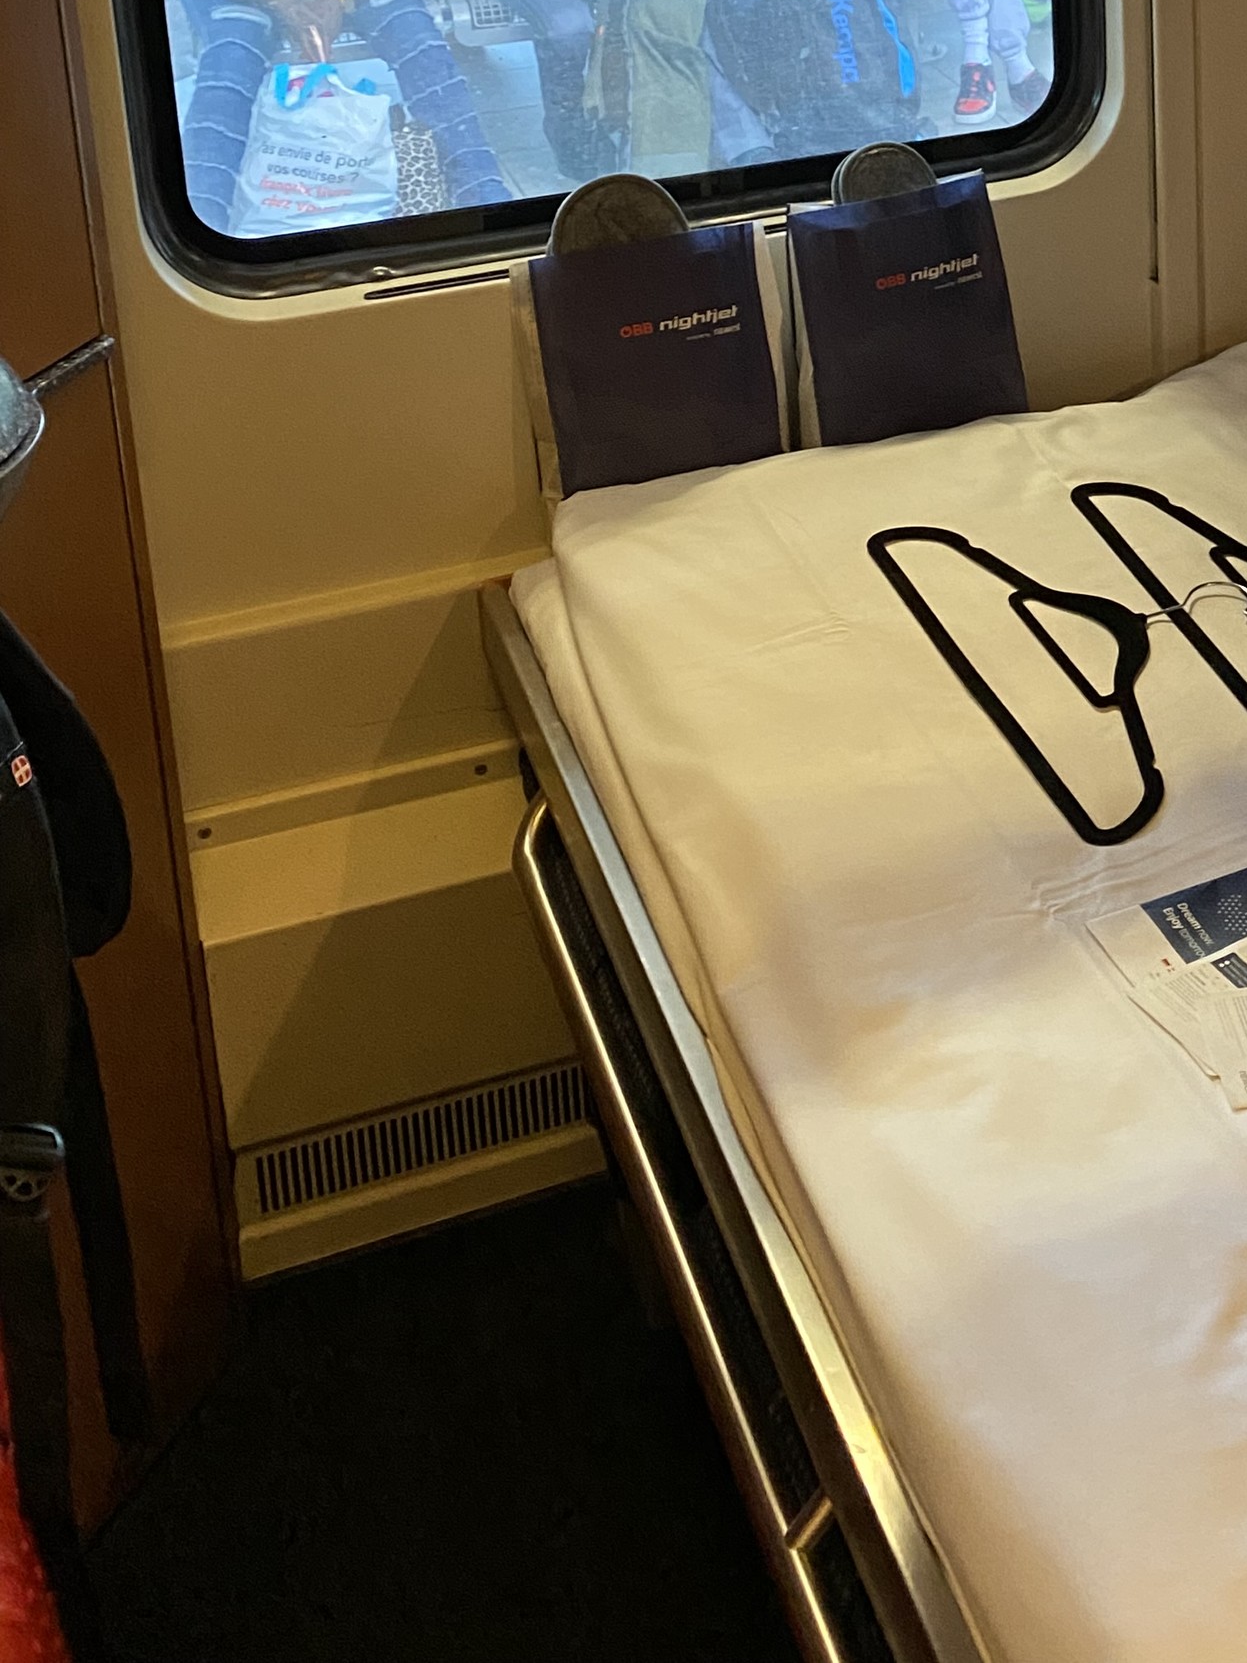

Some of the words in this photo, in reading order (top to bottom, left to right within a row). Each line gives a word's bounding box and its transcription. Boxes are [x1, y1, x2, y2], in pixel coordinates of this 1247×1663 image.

[278, 146, 312, 161] envie
[314, 150, 332, 165] de
[267, 163, 289, 176] vos
[292, 166, 346, 184] courses
[911, 253, 979, 282] nightjet
[660, 304, 738, 331] nightjet
[1177, 902, 1202, 930] Dream
[1162, 907, 1184, 929] Enjoy
[1178, 928, 1206, 958] tomorro
